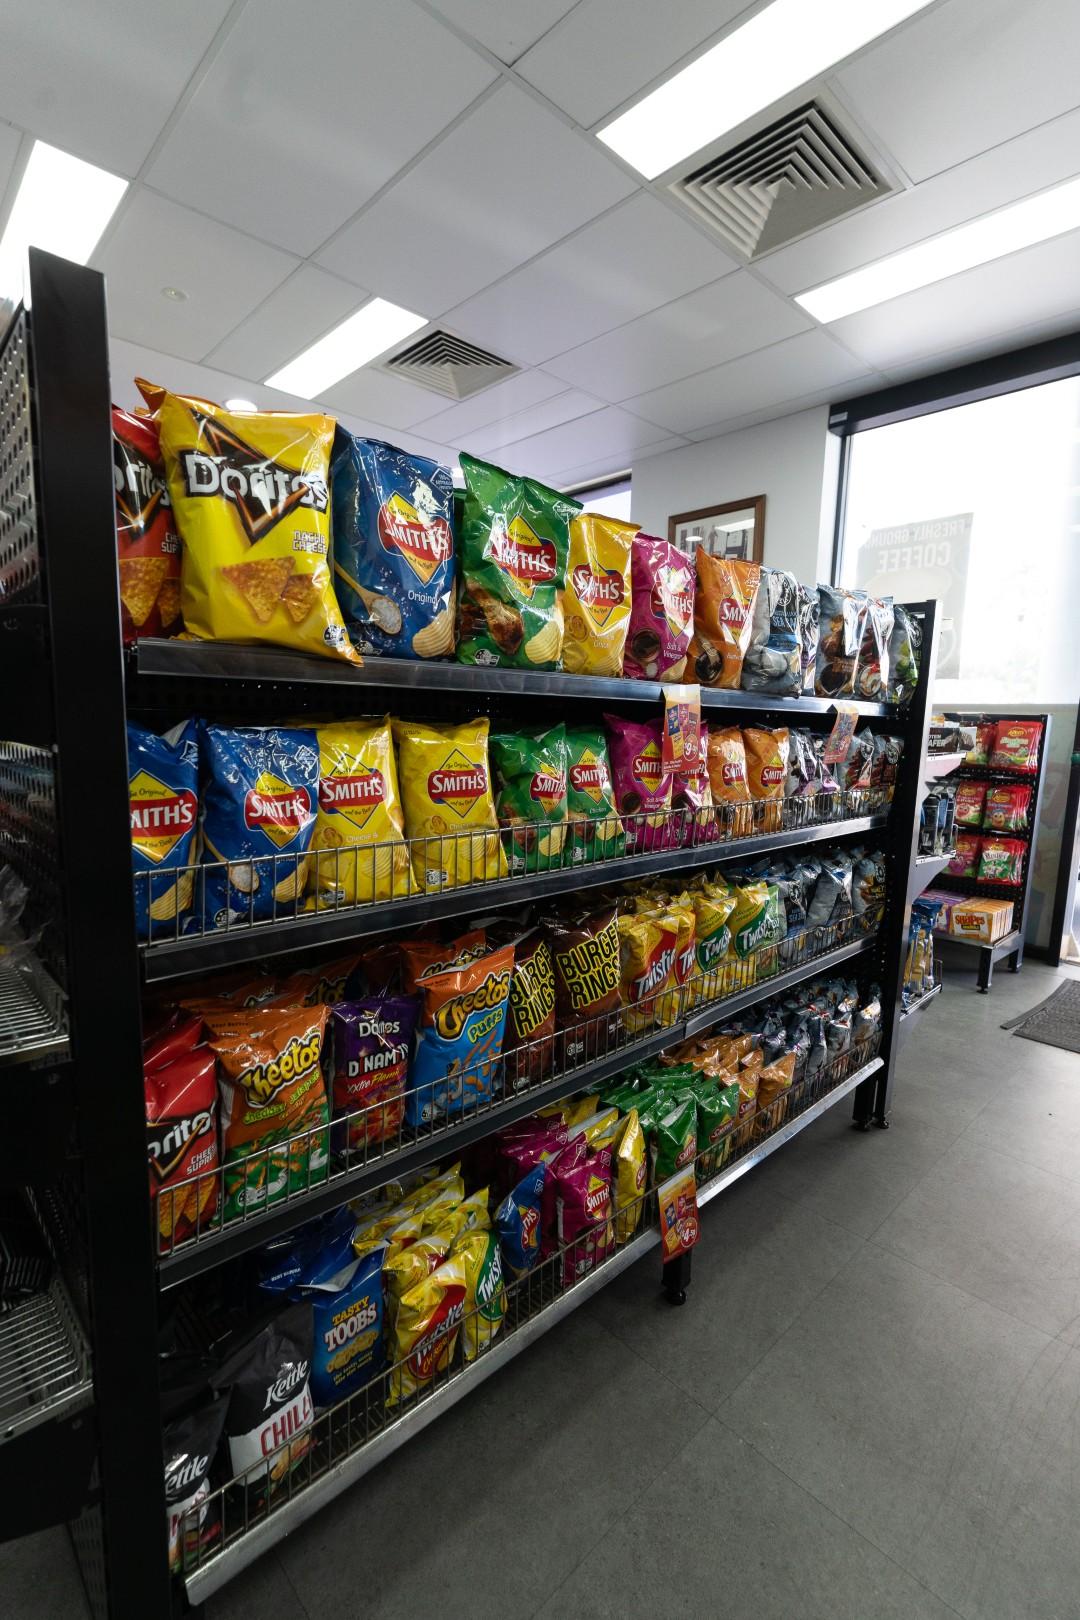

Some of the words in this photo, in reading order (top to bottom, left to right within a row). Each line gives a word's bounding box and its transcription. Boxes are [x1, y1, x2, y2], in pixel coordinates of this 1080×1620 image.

[185, 453, 328, 510] Doritos
[321, 777, 383, 803] SMITH'S
[431, 772, 486, 794] SMITH'S
[248, 794, 308, 818] SMITH'S
[436, 974, 510, 1039] Cheetos
[324, 1302, 378, 1352] TOOBS
[332, 1296, 370, 1327] TASTY
[263, 1360, 308, 1412] Kettle
